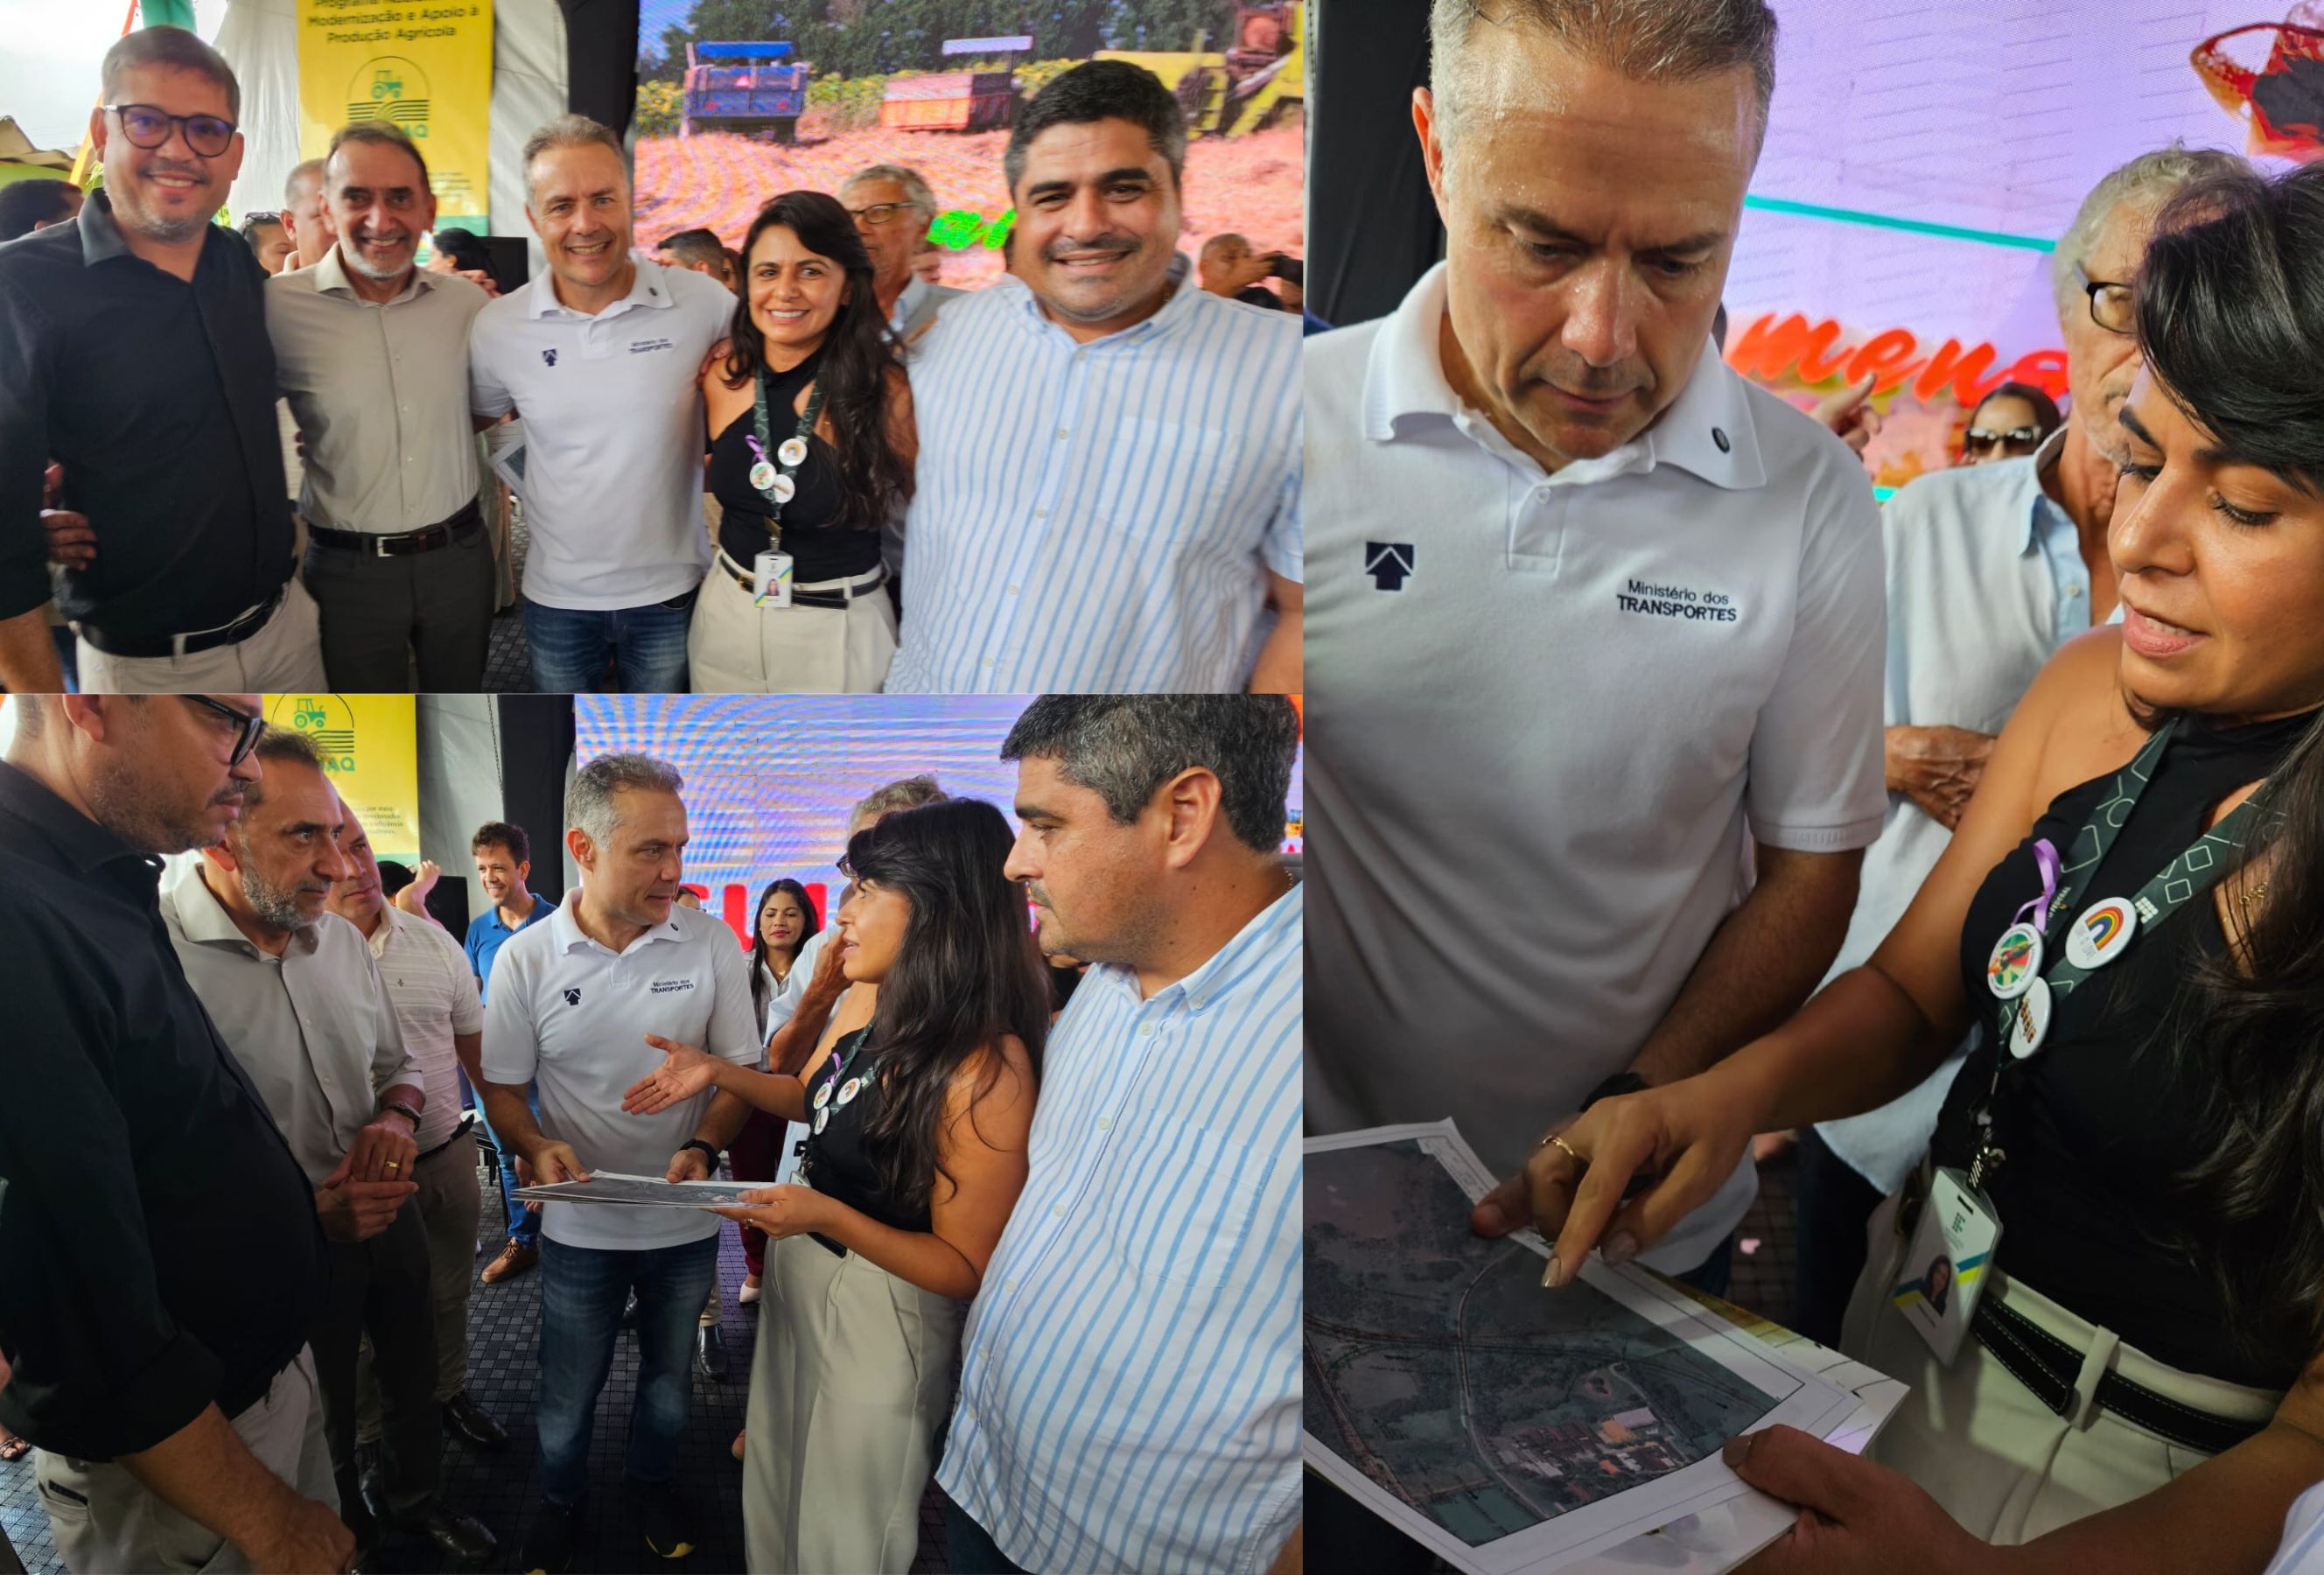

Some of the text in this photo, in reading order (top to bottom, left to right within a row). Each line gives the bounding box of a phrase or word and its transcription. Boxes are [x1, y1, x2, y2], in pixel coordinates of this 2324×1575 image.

[421, 8, 466, 22] Apoio
[327, 29, 391, 43] Produção
[1628, 578, 1730, 606] Ministério dos
[1617, 593, 1738, 622] TRANSPORTES
[651, 984, 693, 994] TRANSPORTES
